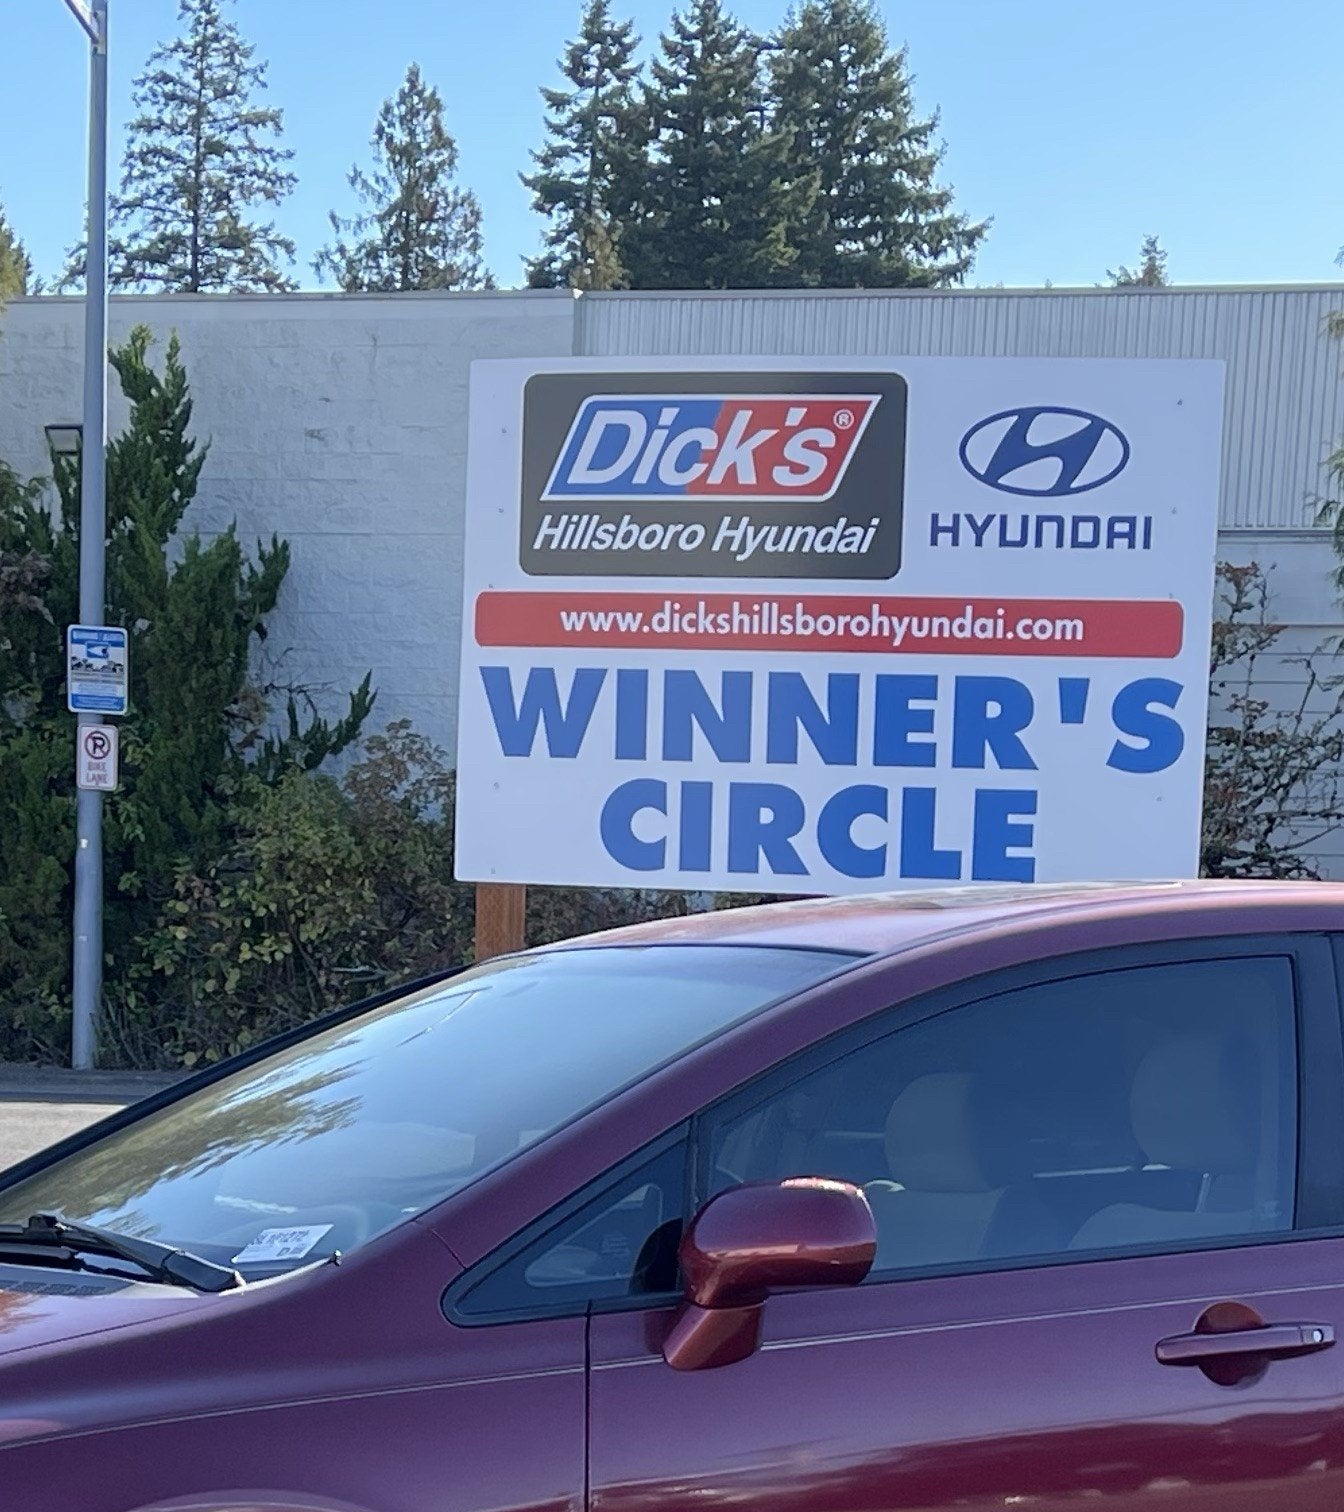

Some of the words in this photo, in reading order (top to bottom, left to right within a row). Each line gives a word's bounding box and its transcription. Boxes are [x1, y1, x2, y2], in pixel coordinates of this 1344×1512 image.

[567, 405, 836, 487] Dick's
[533, 514, 705, 554] Hillsboro
[711, 517, 879, 561] Hyundai
[929, 512, 1153, 550] HYUNDAI
[560, 602, 1085, 646] www.dickshillsborohyundai.com
[479, 664, 1185, 774] WINNER'S
[600, 777, 1038, 882] CIRCLE
